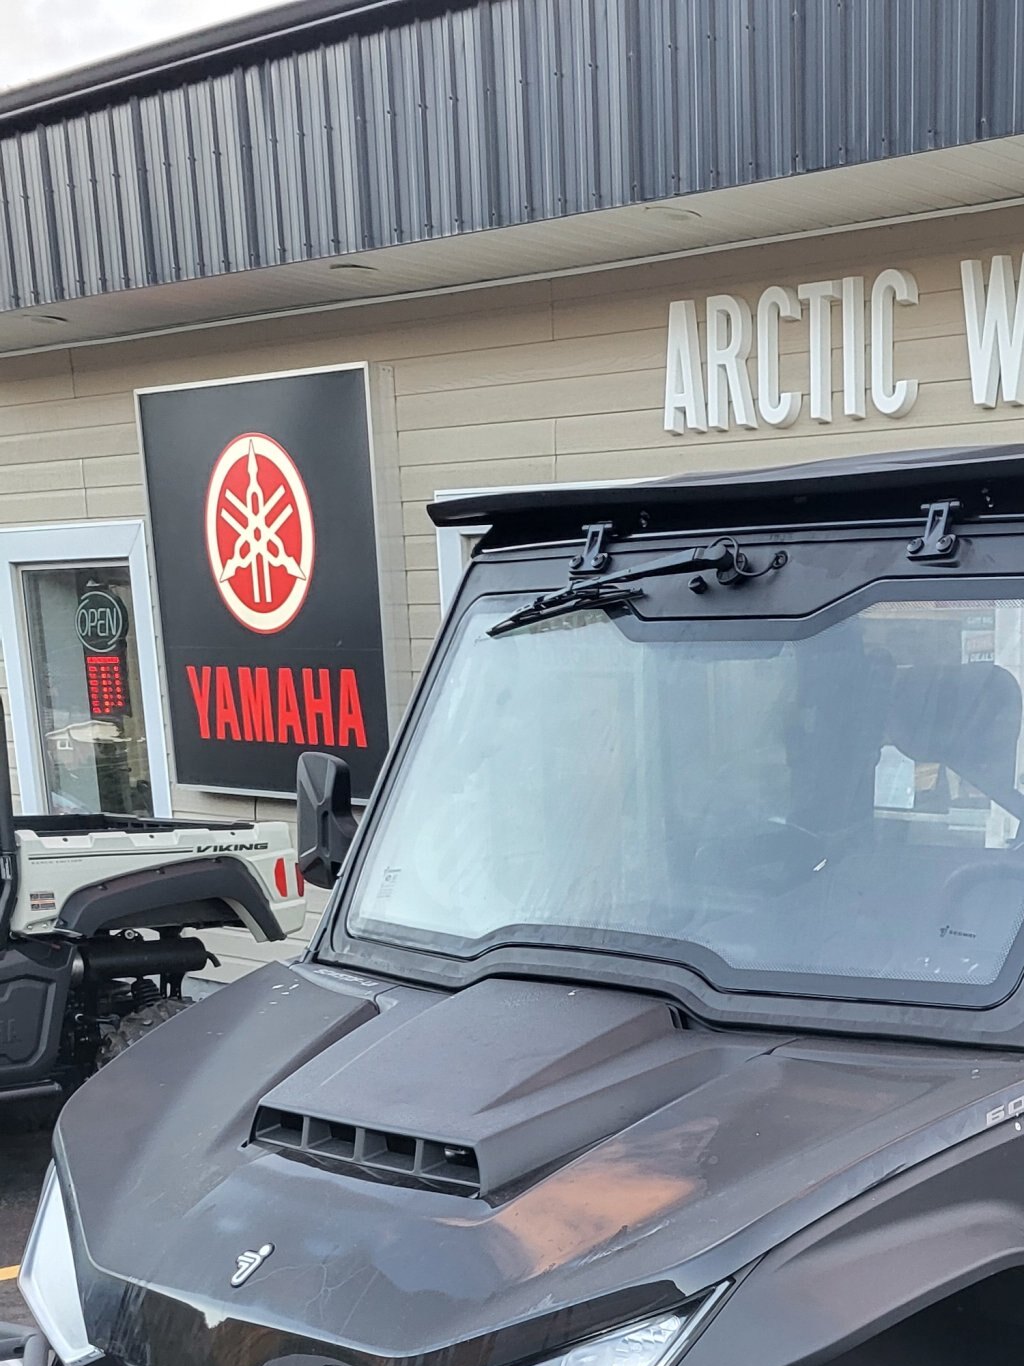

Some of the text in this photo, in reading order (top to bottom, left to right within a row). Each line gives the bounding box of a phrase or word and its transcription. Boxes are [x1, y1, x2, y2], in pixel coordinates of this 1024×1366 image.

[664, 268, 919, 435] ARCTIC
[78, 608, 117, 636] OPEN
[186, 665, 368, 748] YAMAHA
[196, 842, 269, 854] VIKING
